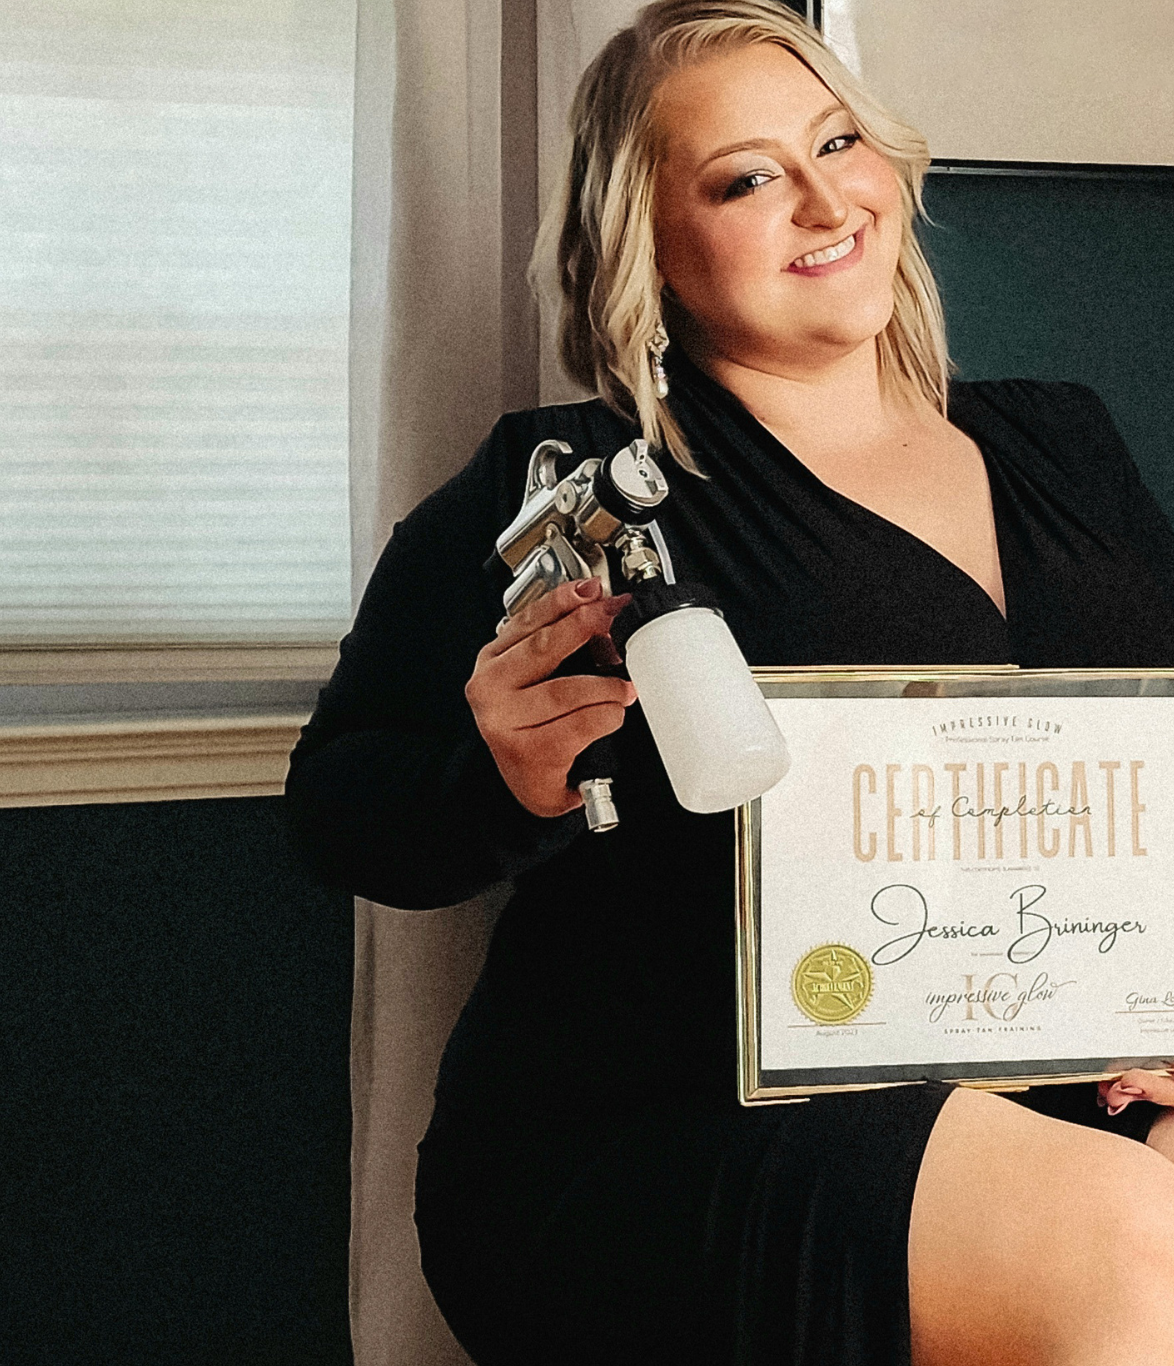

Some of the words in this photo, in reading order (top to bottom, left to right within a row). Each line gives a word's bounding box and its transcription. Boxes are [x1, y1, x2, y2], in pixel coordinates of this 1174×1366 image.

[932, 715, 1018, 736] IMPRESSIVE
[852, 760, 1148, 863] CERTIFICATE
[910, 804, 942, 828] of
[951, 795, 1093, 827] Completion
[871, 883, 999, 966] Jessica
[1007, 883, 1147, 964] Brininger
[925, 989, 1012, 1023] impressive
[1002, 971, 1078, 1022] glow
